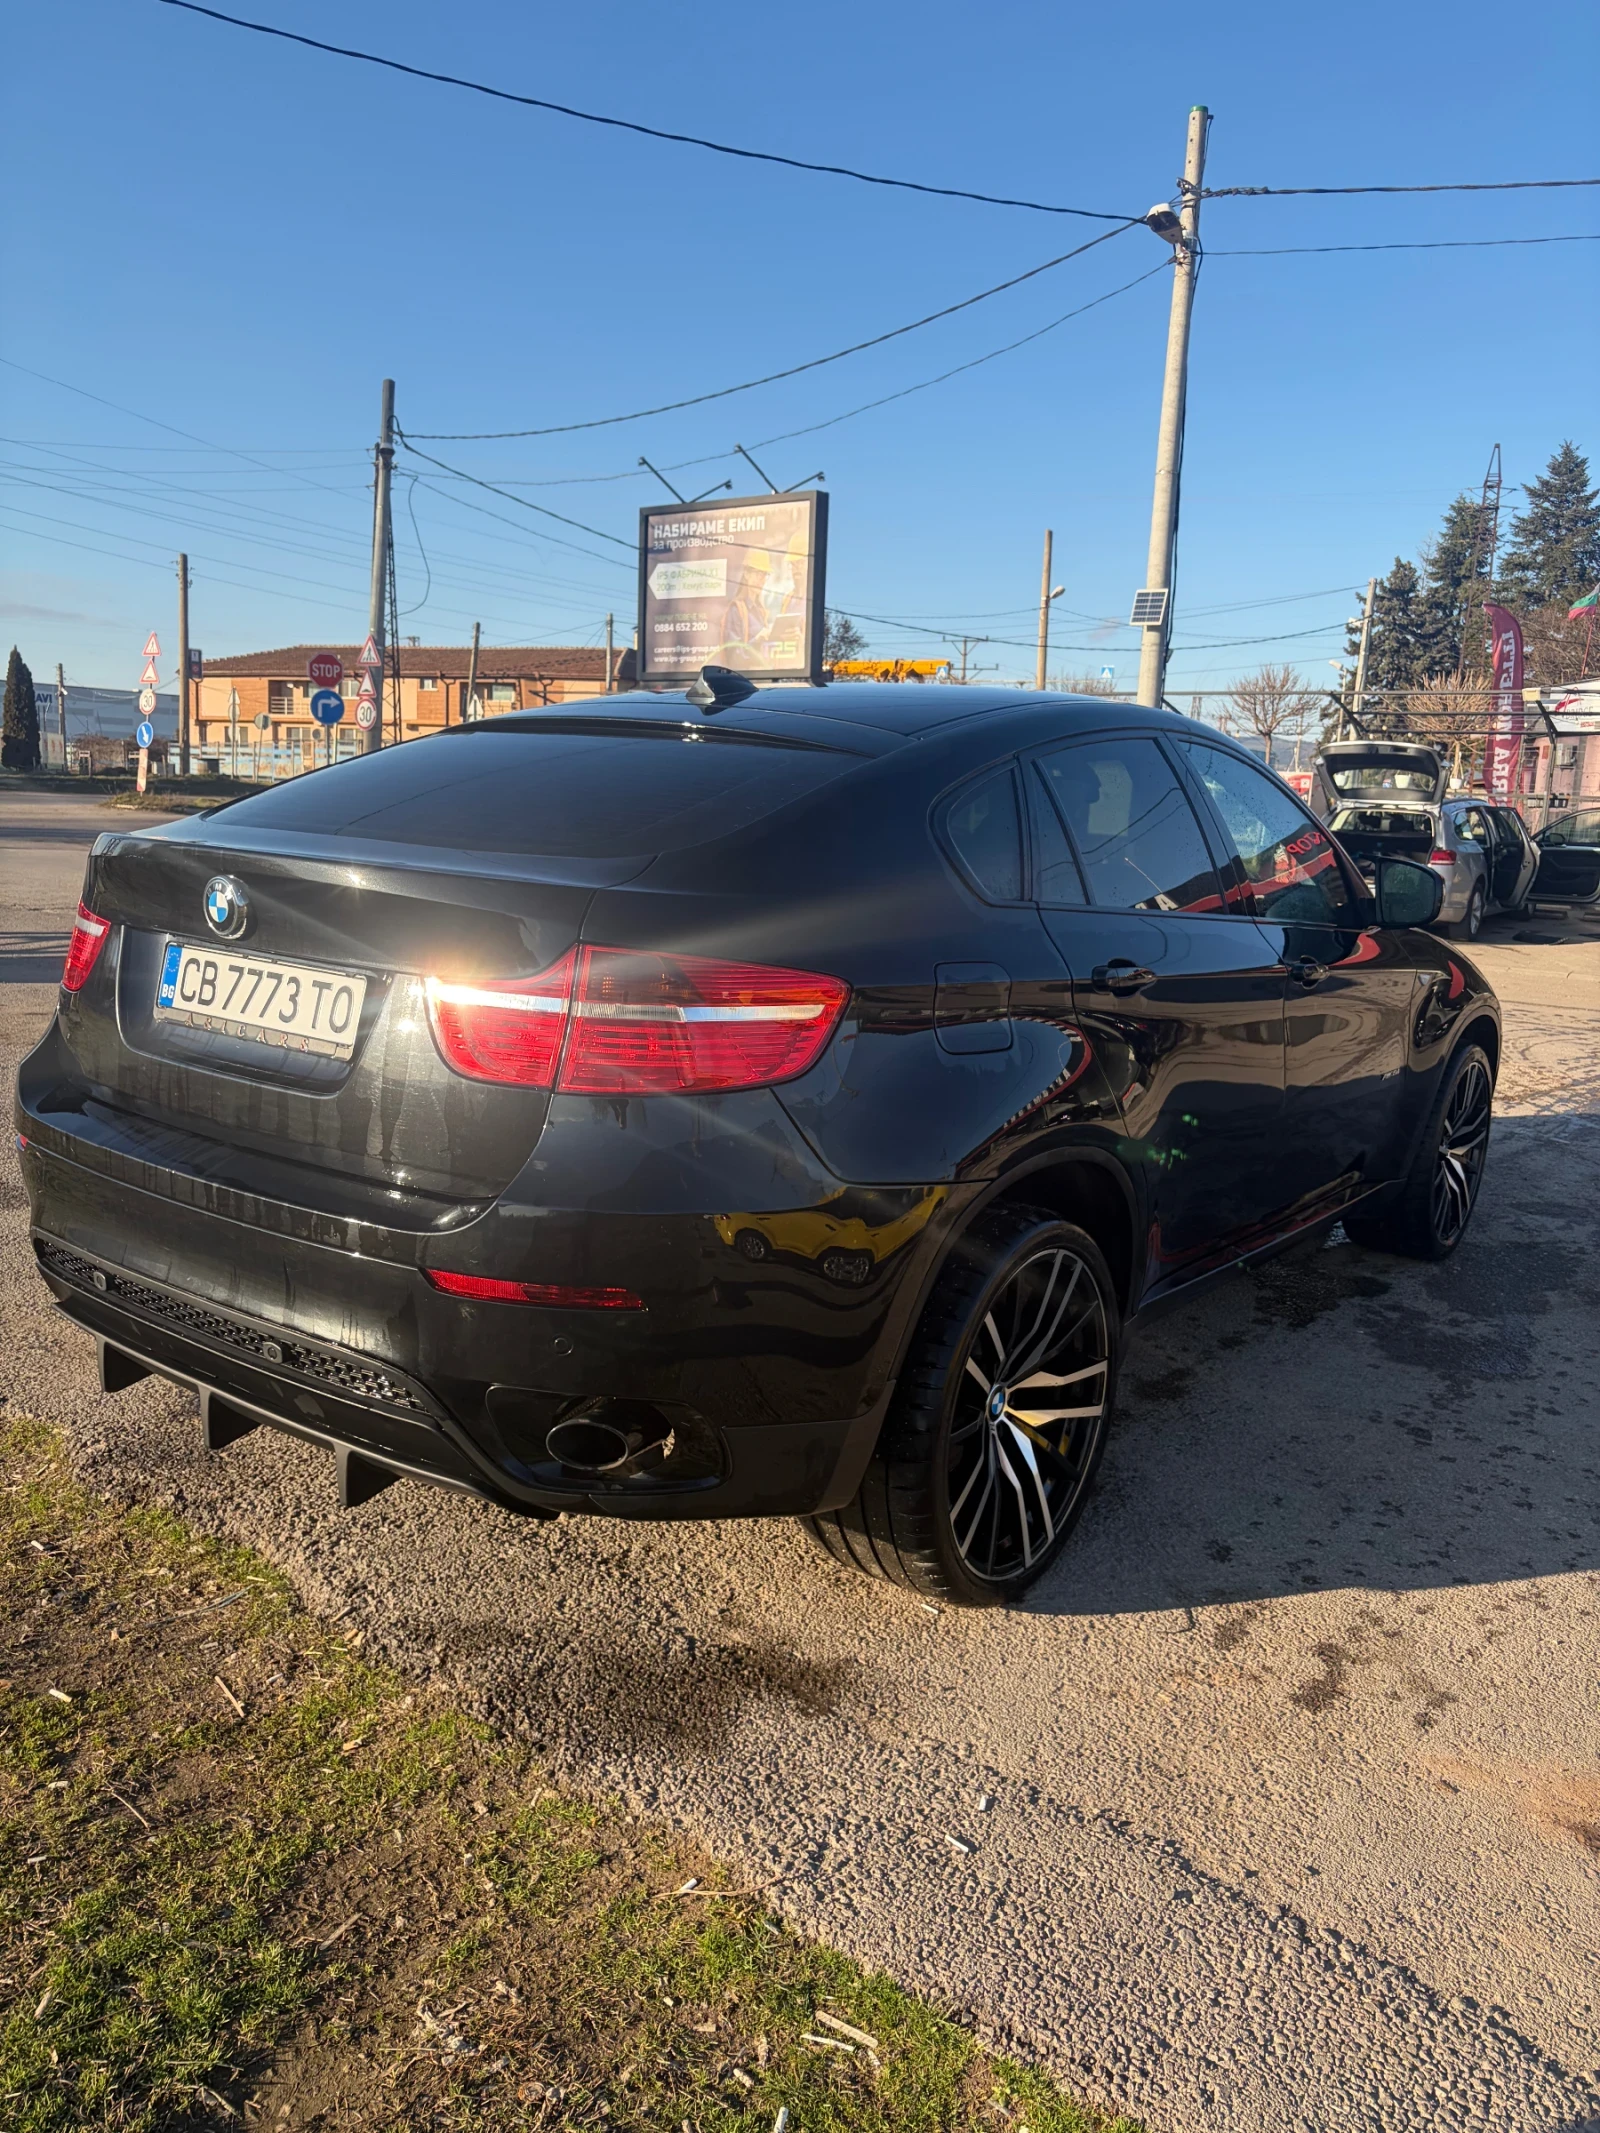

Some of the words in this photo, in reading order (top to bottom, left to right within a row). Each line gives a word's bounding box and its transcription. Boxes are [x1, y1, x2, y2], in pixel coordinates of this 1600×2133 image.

[654, 520, 725, 538] НАБИРАМЕ
[728, 516, 765, 532] ЕКИП
[653, 541, 664, 550] за
[666, 535, 734, 550] производство
[654, 623, 674, 632] 0884
[676, 622, 690, 631] 652
[692, 621, 708, 631] 200
[312, 664, 340, 678] STOP
[143, 695, 153, 708] 30
[360, 706, 372, 722] 30
[161, 983, 174, 998] BG
[180, 957, 218, 1006] CB
[221, 964, 301, 1023] 7773
